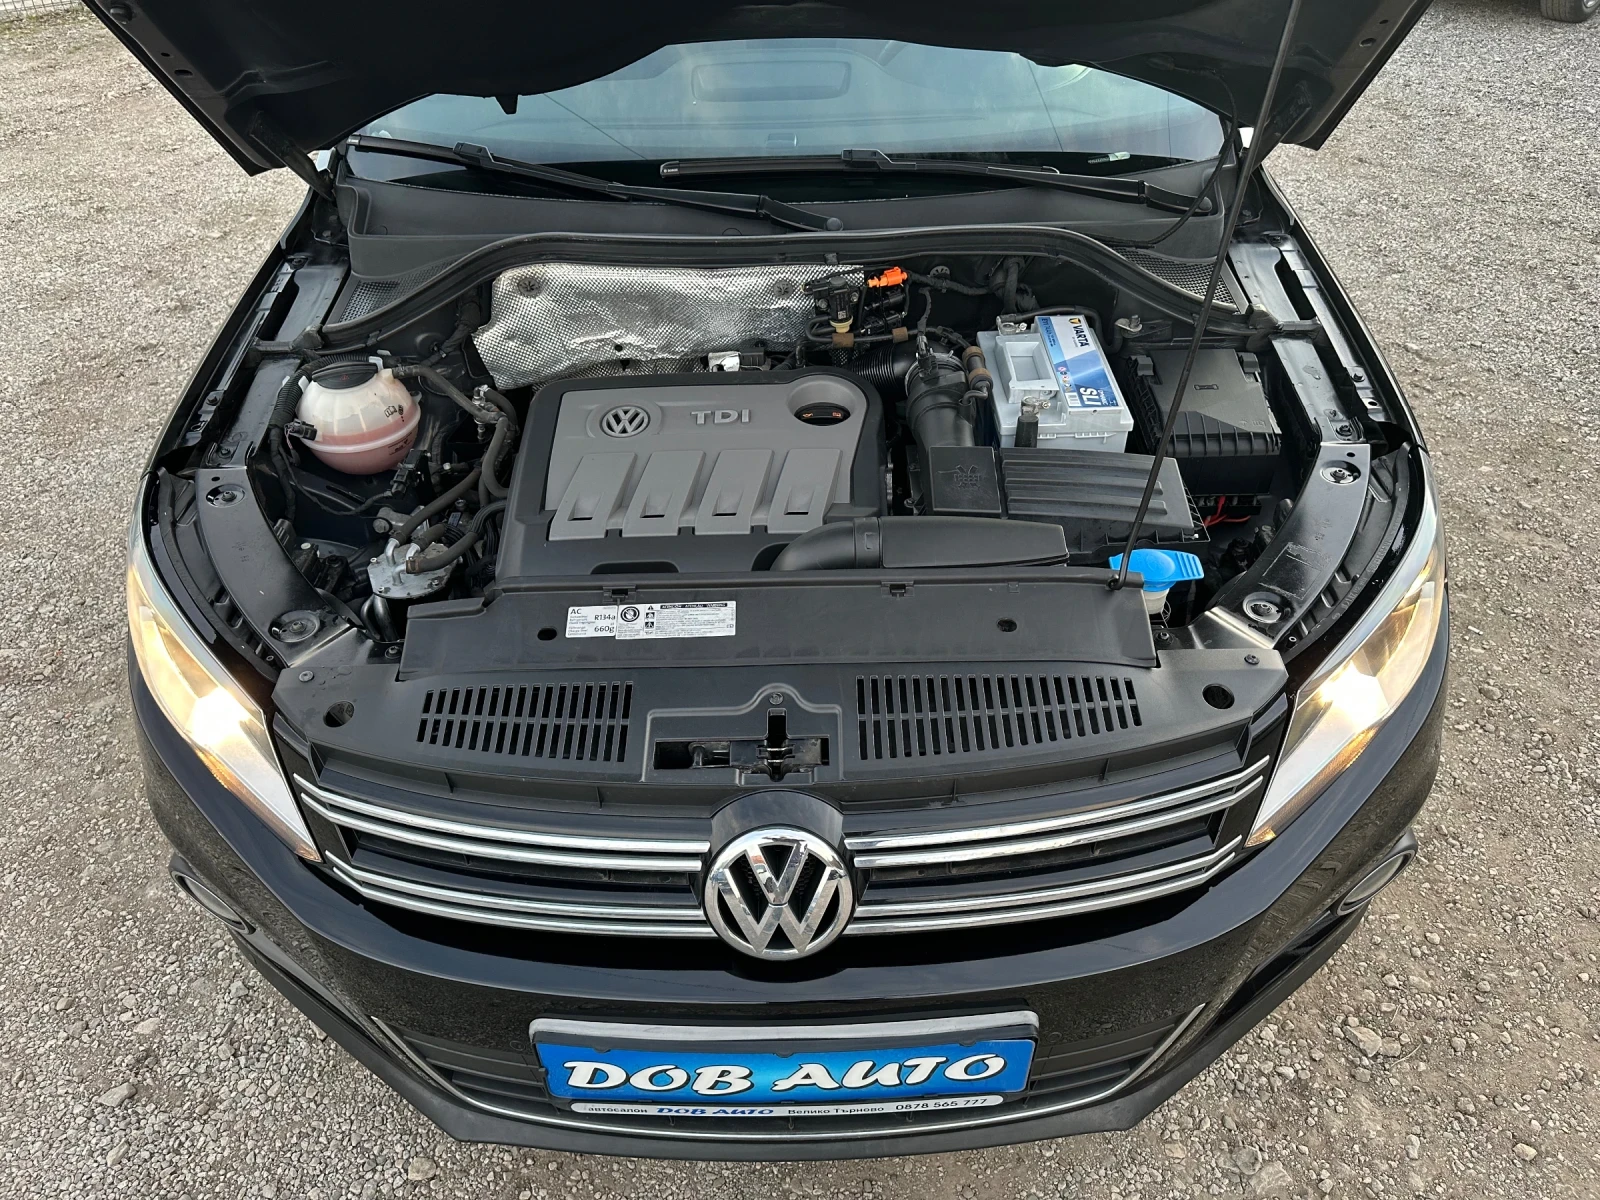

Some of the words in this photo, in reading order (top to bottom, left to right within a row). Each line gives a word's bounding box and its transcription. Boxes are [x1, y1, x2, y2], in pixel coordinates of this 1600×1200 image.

[1073, 324, 1089, 346] VARTA
[1079, 387, 1102, 406] SLI
[690, 408, 751, 426] TDI
[593, 625, 615, 634] 660g
[704, 828, 854, 961] VW
[562, 1061, 755, 1096] DOB
[770, 1053, 1008, 1092] AUTO
[588, 1106, 648, 1114] автосалон
[656, 1107, 706, 1115] DOB
[834, 1106, 885, 1114] Търново
[895, 1101, 929, 1111] 0878
[933, 1100, 957, 1109] 565
[963, 1098, 988, 1107] 777
